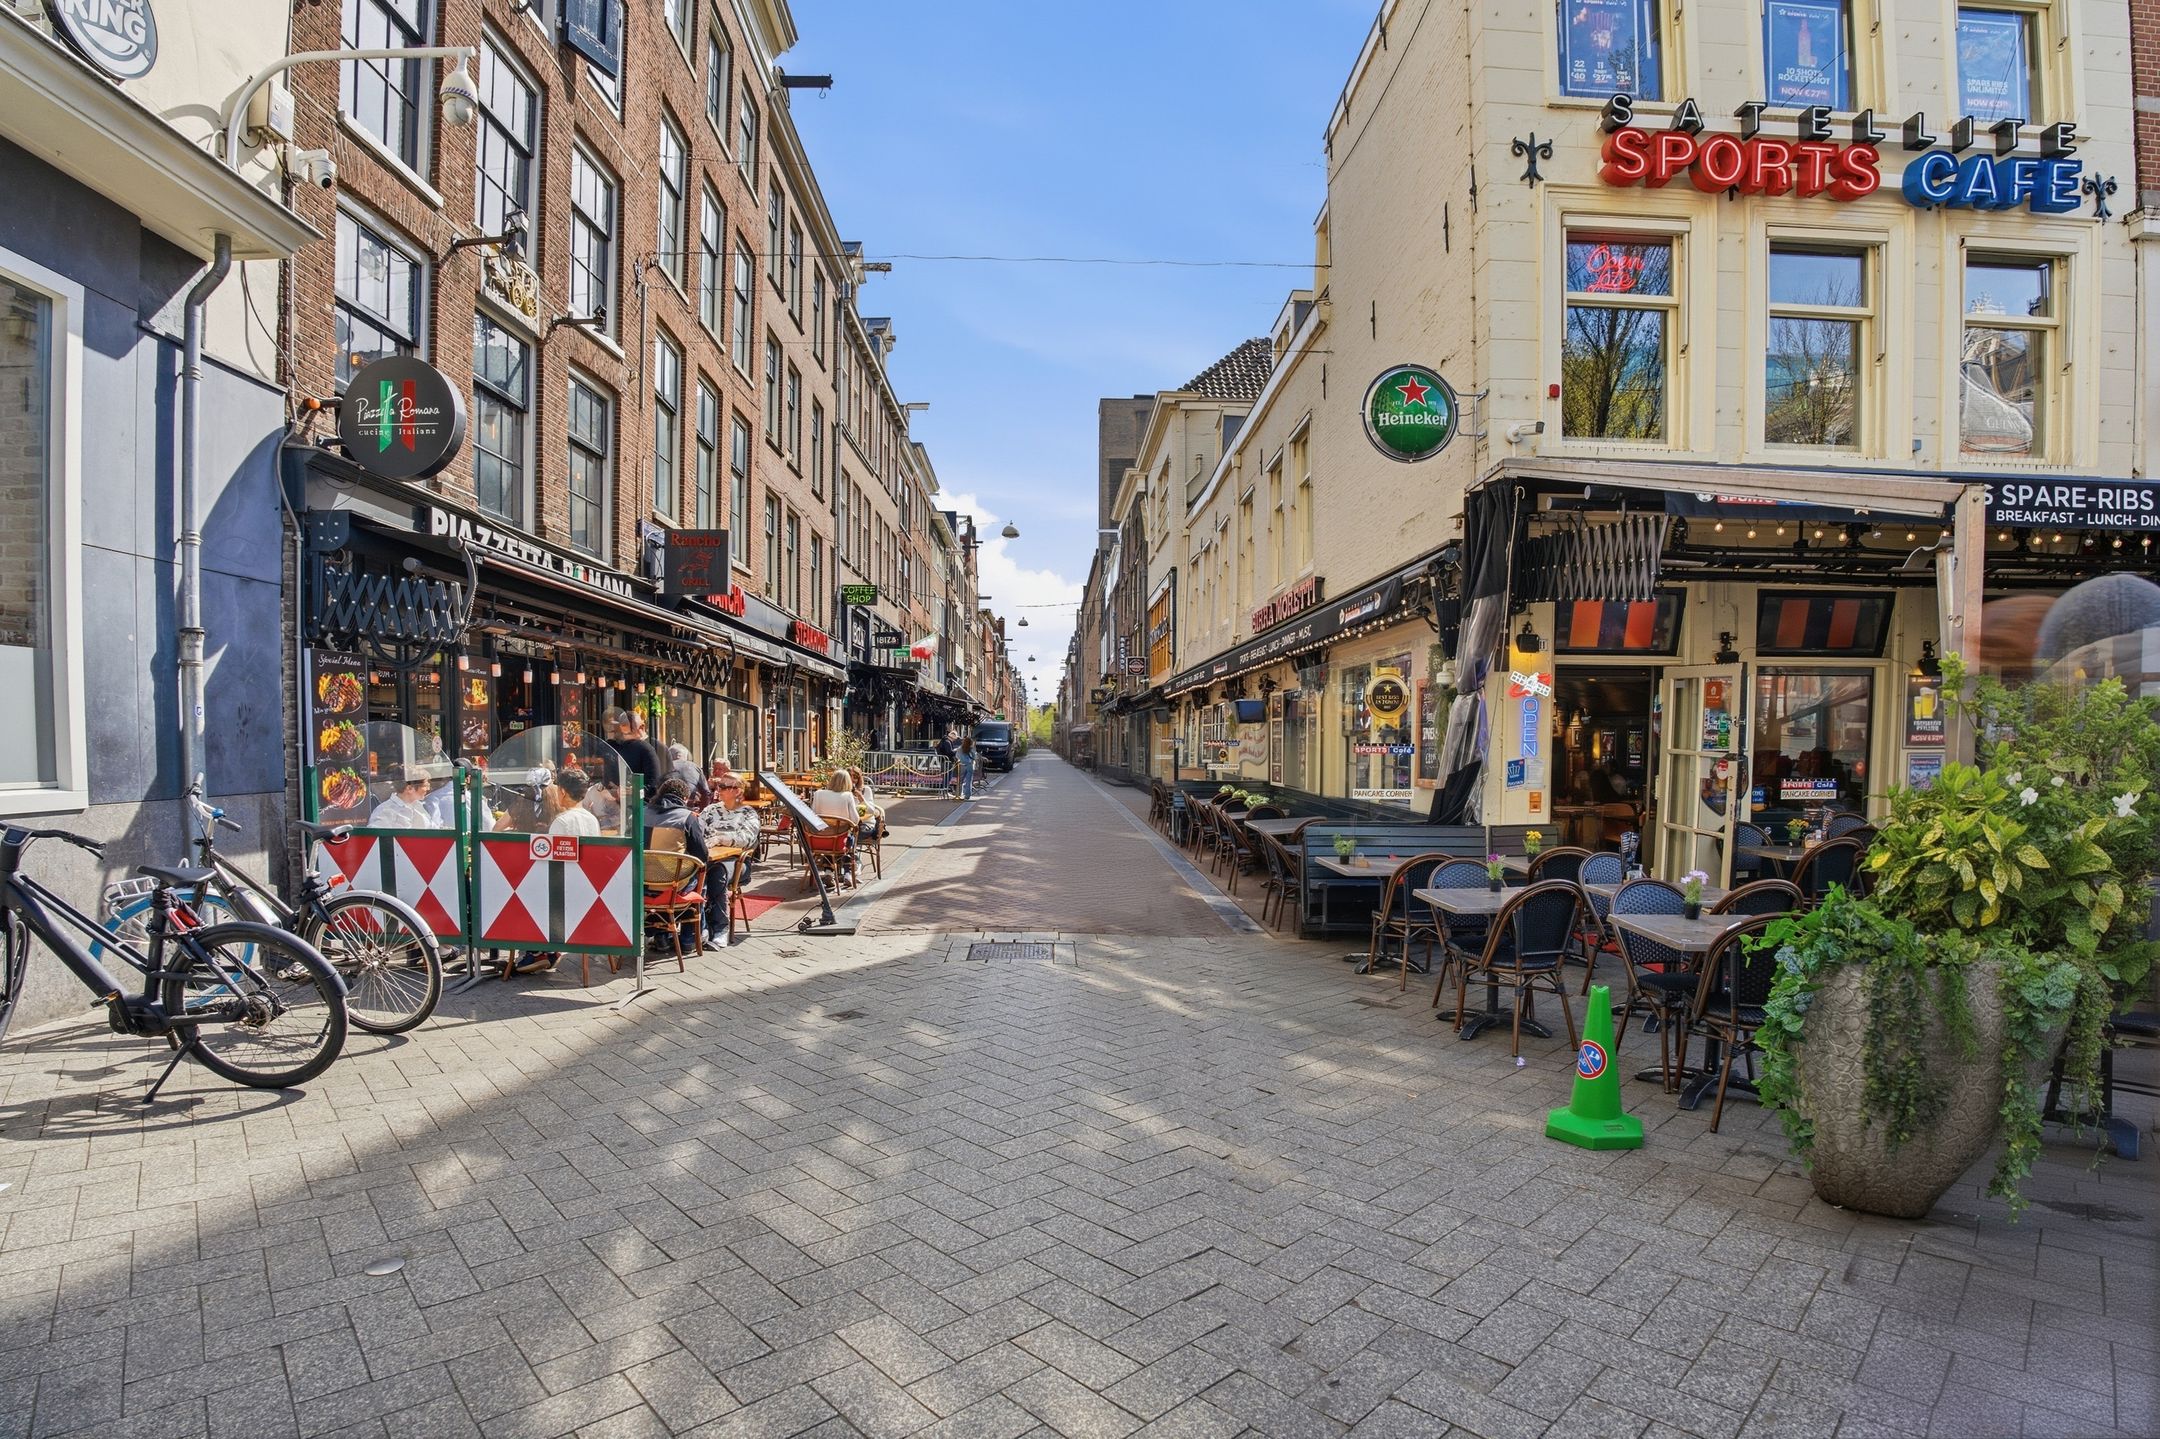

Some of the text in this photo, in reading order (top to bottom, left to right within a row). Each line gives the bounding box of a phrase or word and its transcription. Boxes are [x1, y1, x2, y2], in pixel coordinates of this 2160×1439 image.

[1601, 93, 2077, 159] SATELLITE
[1601, 127, 2083, 213] SPORTS CAFE
[1586, 243, 1645, 272] Open
[1378, 411, 1448, 427] Heineken
[2001, 484, 2155, 511] SPARE-RIBS
[1996, 510, 2075, 524] BREAKFAST
[431, 506, 633, 599] PIAZZETTA ROMANA
[671, 533, 720, 547] Rancho
[842, 586, 876, 595] COFFEE
[847, 595, 871, 603] SHOP
[1252, 604, 1276, 634] BIRRA
[1275, 575, 1316, 623] MORETTI
[1523, 698, 1538, 756] OPEN
